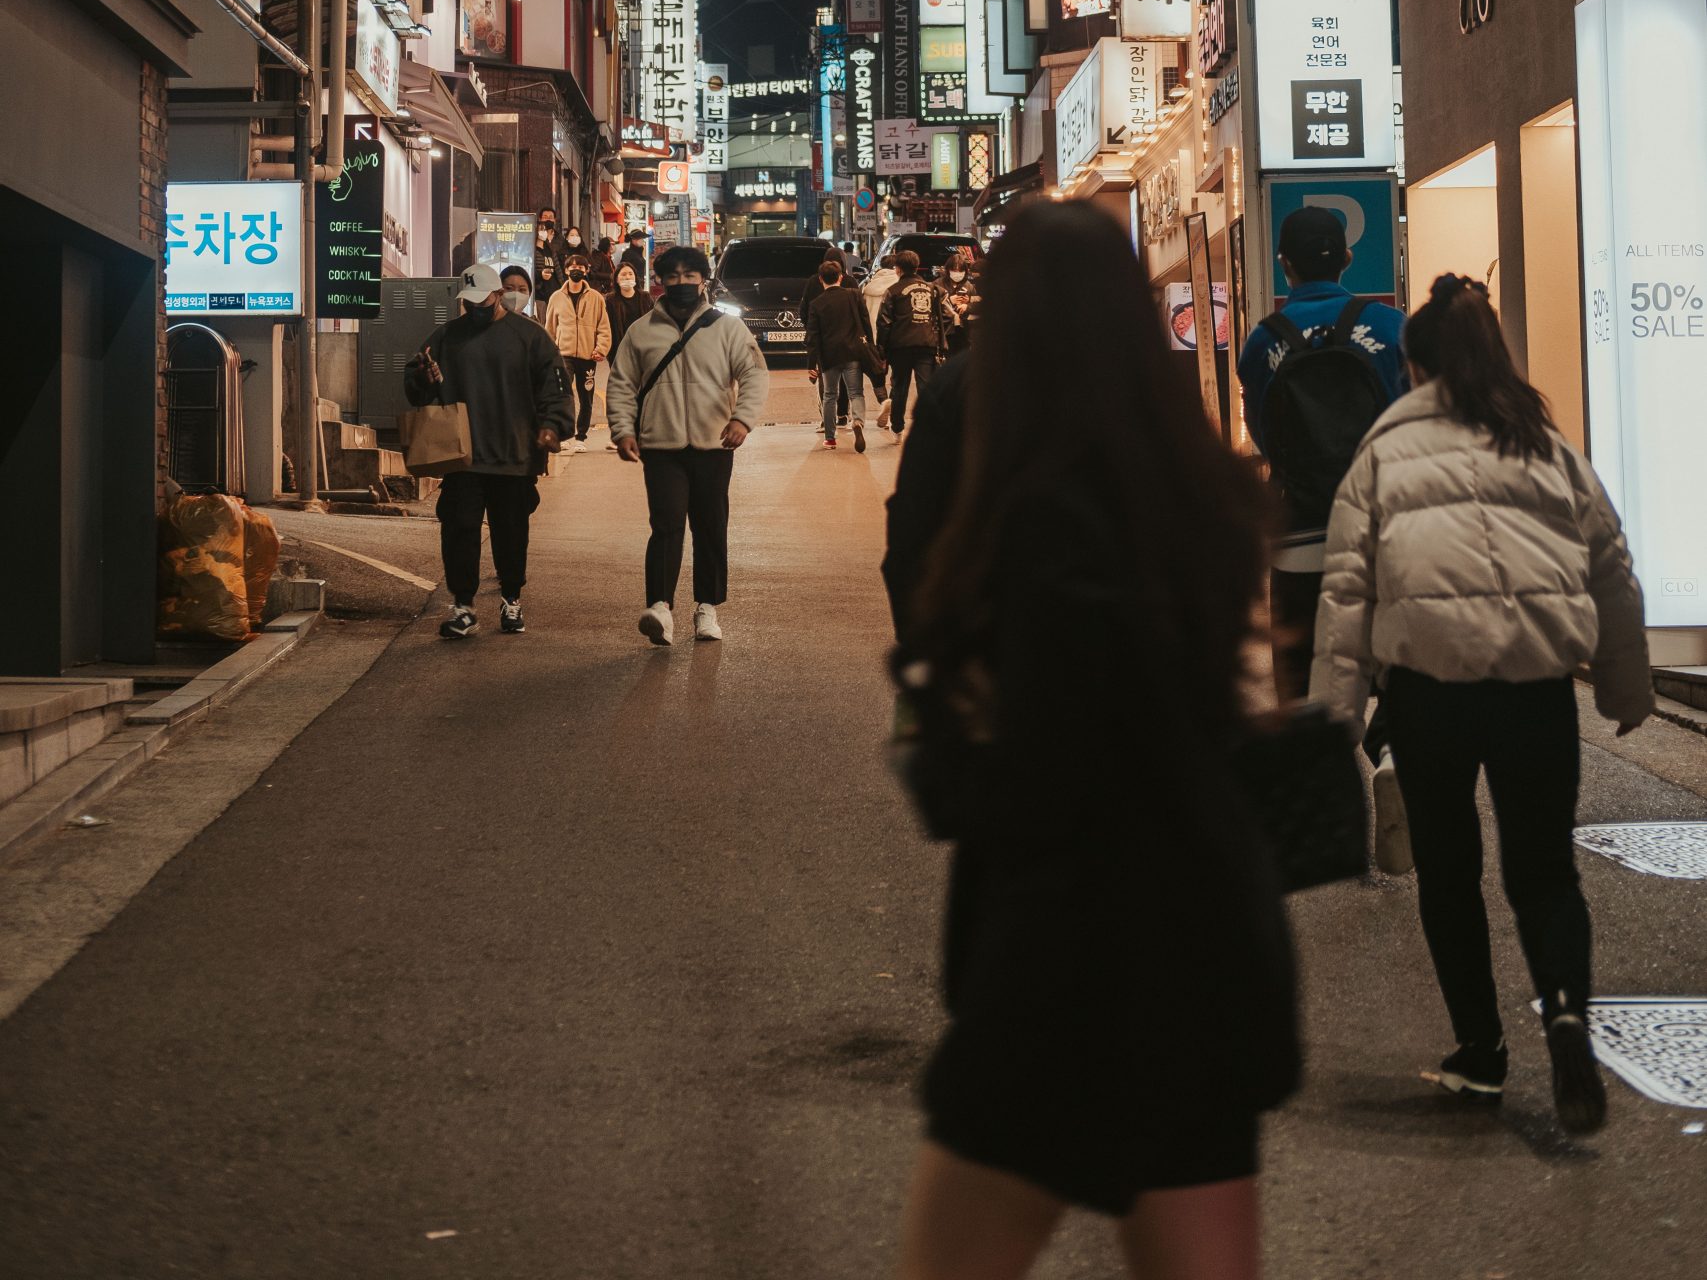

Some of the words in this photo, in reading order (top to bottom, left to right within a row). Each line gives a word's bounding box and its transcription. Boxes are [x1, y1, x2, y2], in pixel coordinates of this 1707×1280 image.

[1311, 16, 1339, 30] 육회
[1311, 36, 1340, 49] 연어
[1305, 53, 1348, 67] 전문점
[706, 95, 725, 103] 원조
[854, 66, 873, 121] CRAFT
[1305, 90, 1349, 114] 무한
[706, 108, 725, 165] 부안집
[884, 121, 920, 138] 고수
[1306, 123, 1350, 146] 제공
[856, 123, 874, 169] HANS
[329, 221, 364, 233] COFFEE
[329, 246, 368, 257] WHISKY
[1625, 244, 1653, 257] ALL
[1657, 244, 1704, 257] ITEMS
[328, 270, 371, 281] COCKTAIL
[327, 294, 364, 305] HOOKAH
[1630, 282, 1703, 312] 50%
[1631, 315, 1705, 338] SALE
